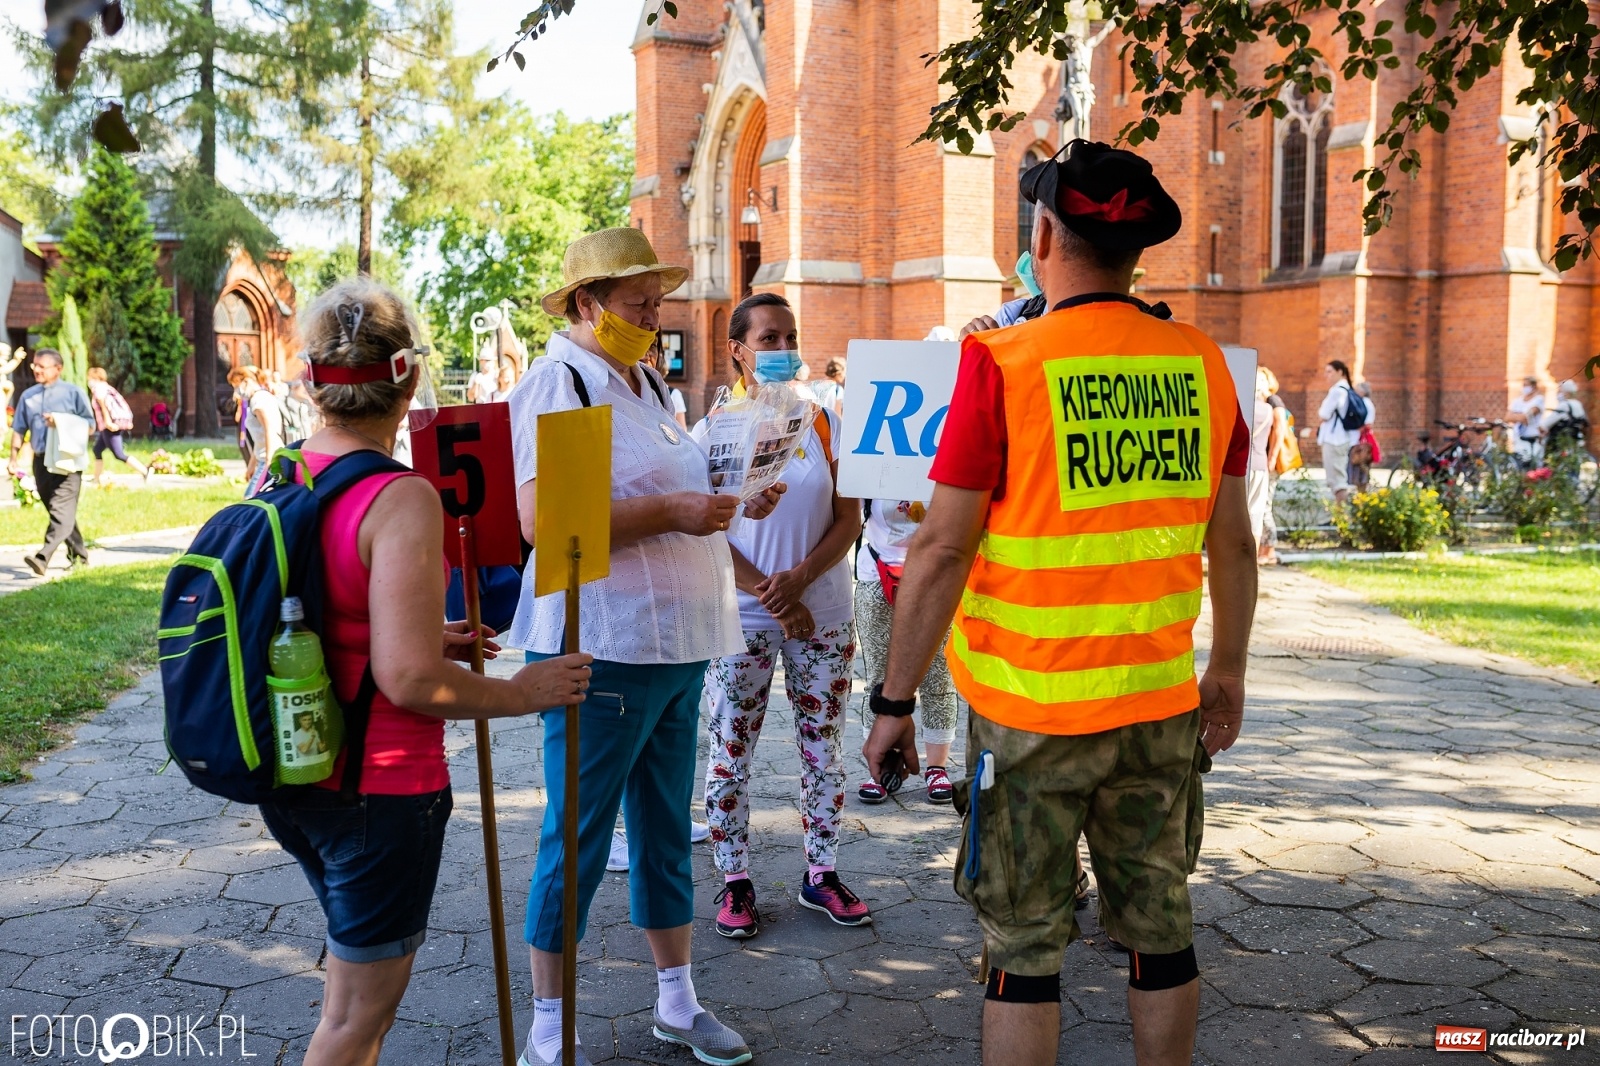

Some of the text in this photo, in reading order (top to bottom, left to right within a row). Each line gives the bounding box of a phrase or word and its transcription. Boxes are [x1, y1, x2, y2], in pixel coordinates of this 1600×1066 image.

[1058, 373, 1200, 422] KIEROWANIE
[435, 421, 486, 519] 5
[1066, 427, 1203, 489] RUCHEM
